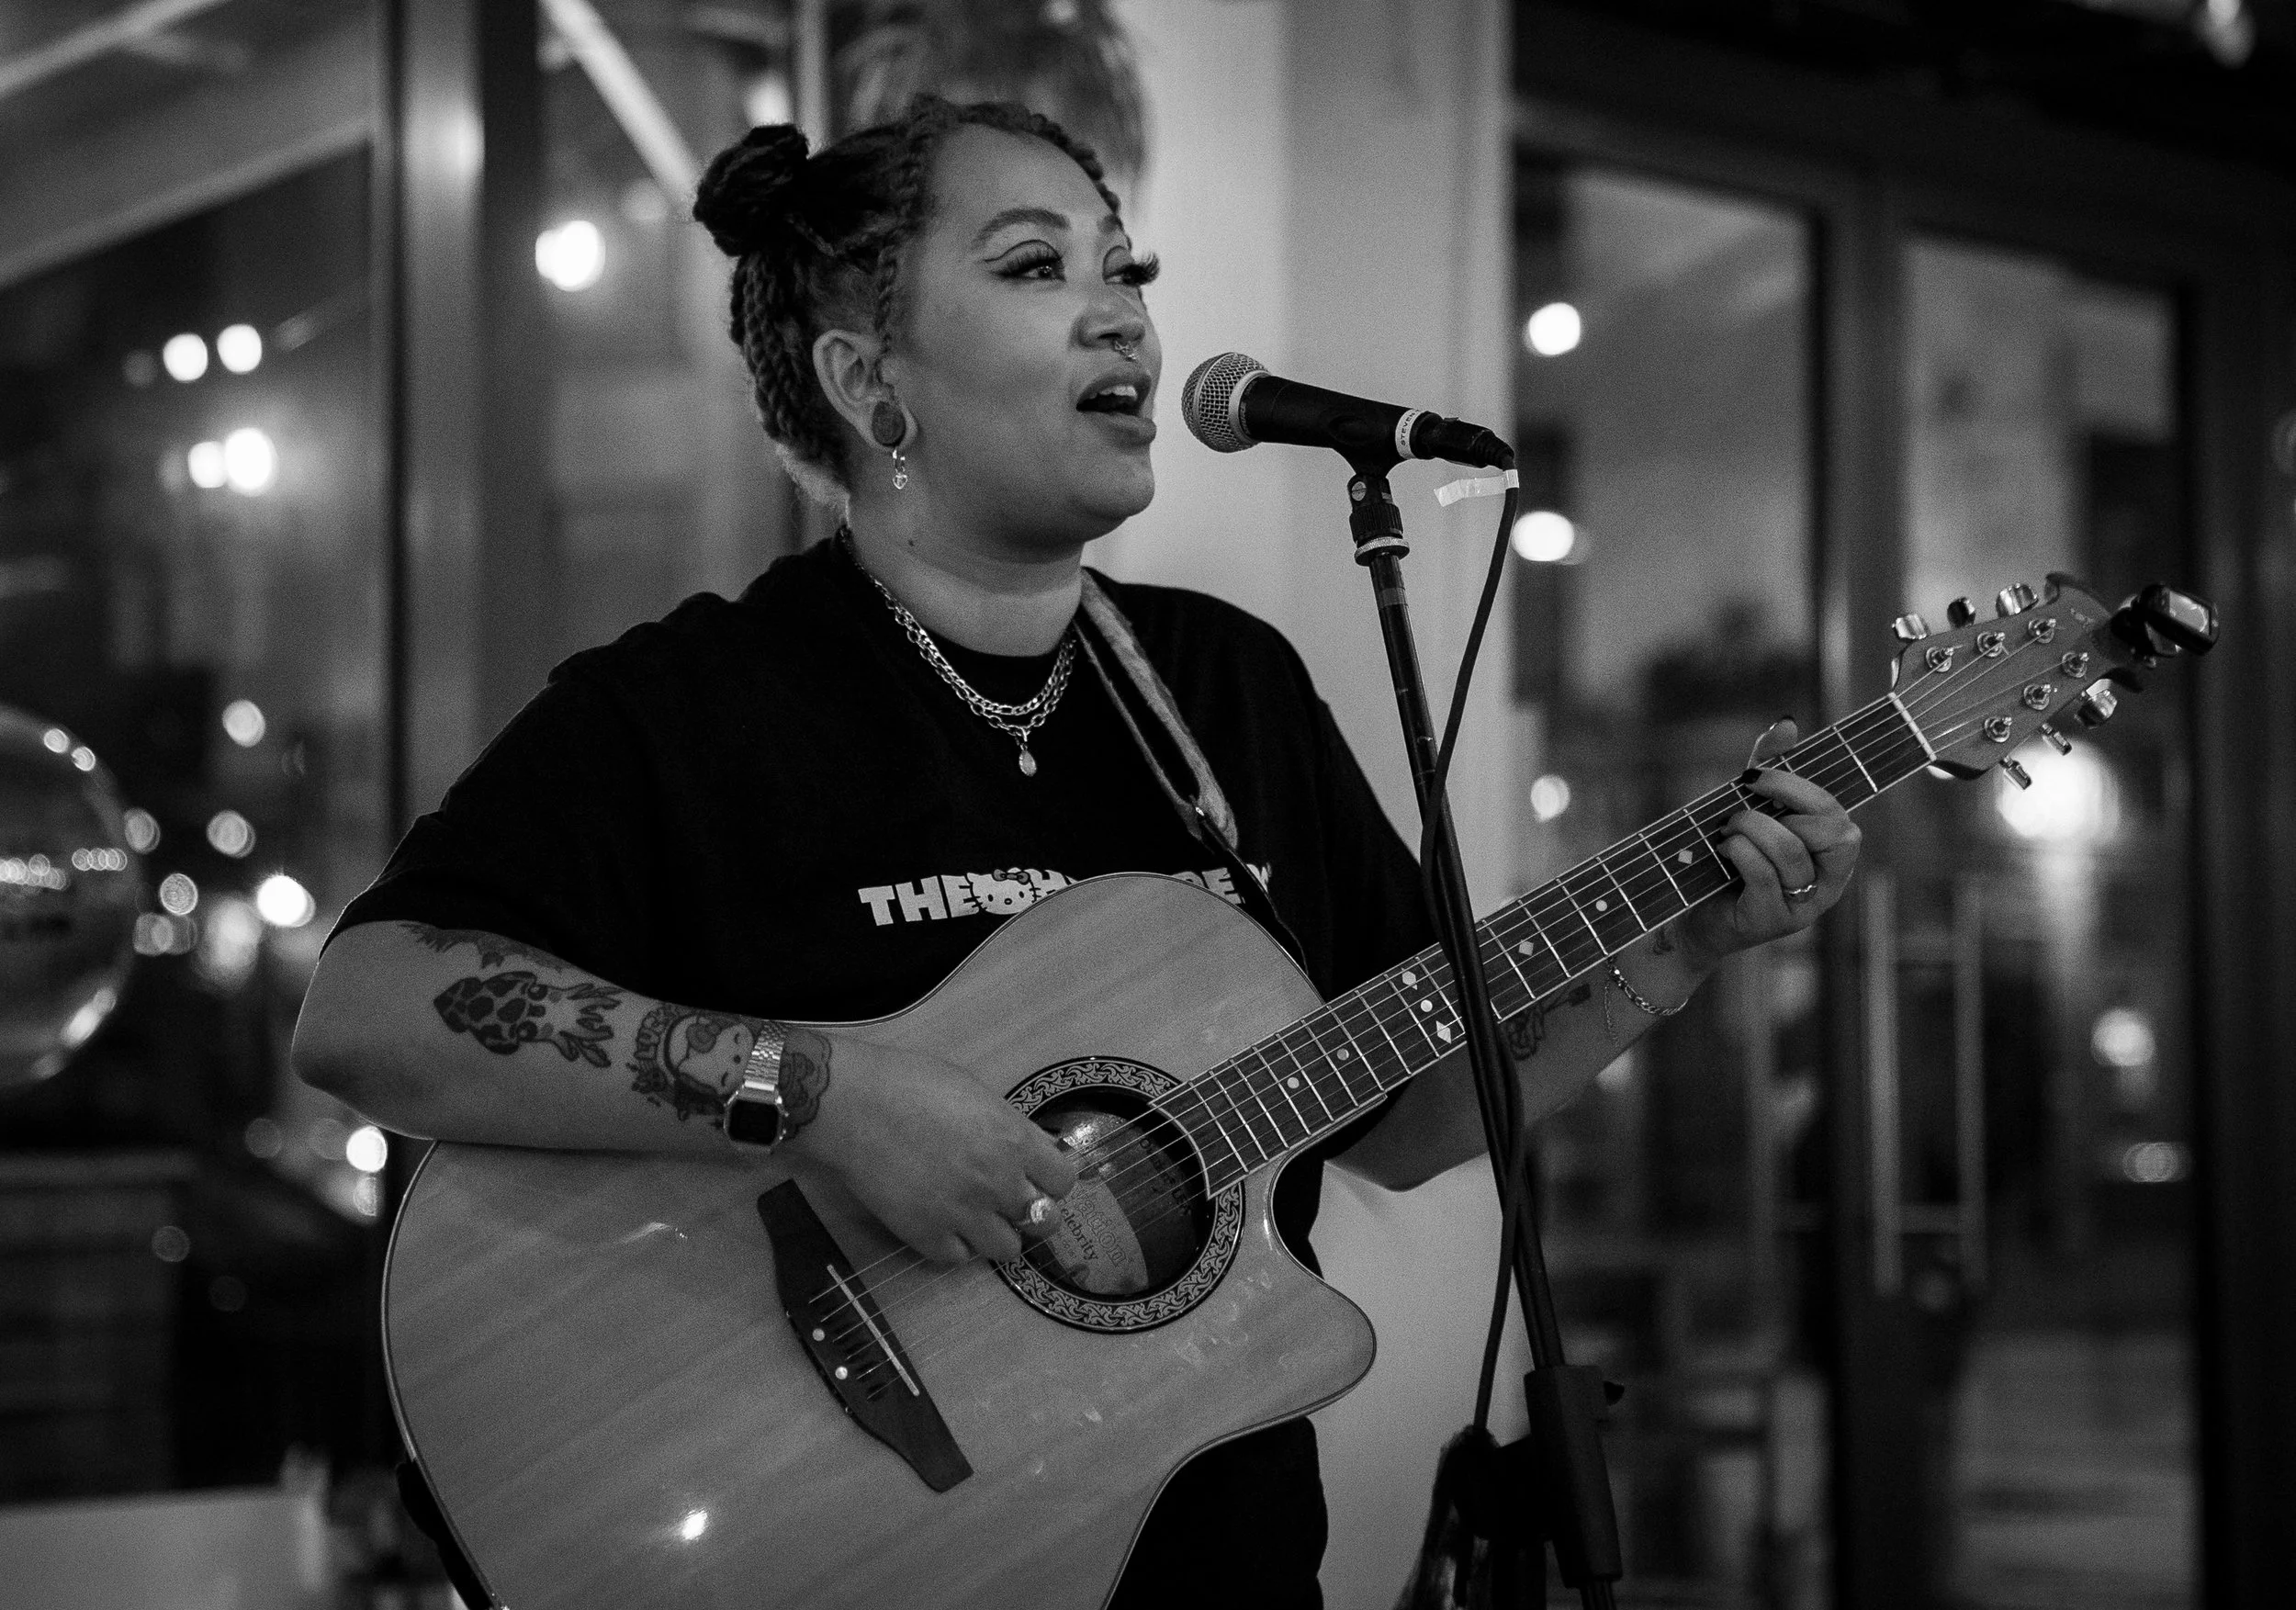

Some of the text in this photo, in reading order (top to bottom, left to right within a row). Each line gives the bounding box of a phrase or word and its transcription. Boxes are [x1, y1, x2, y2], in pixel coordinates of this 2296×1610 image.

[1401, 412, 1416, 446] STEVEN
[858, 875, 980, 926] THE
[1058, 1200, 1099, 1260] elebrity
[1071, 1180, 1127, 1267] vation
